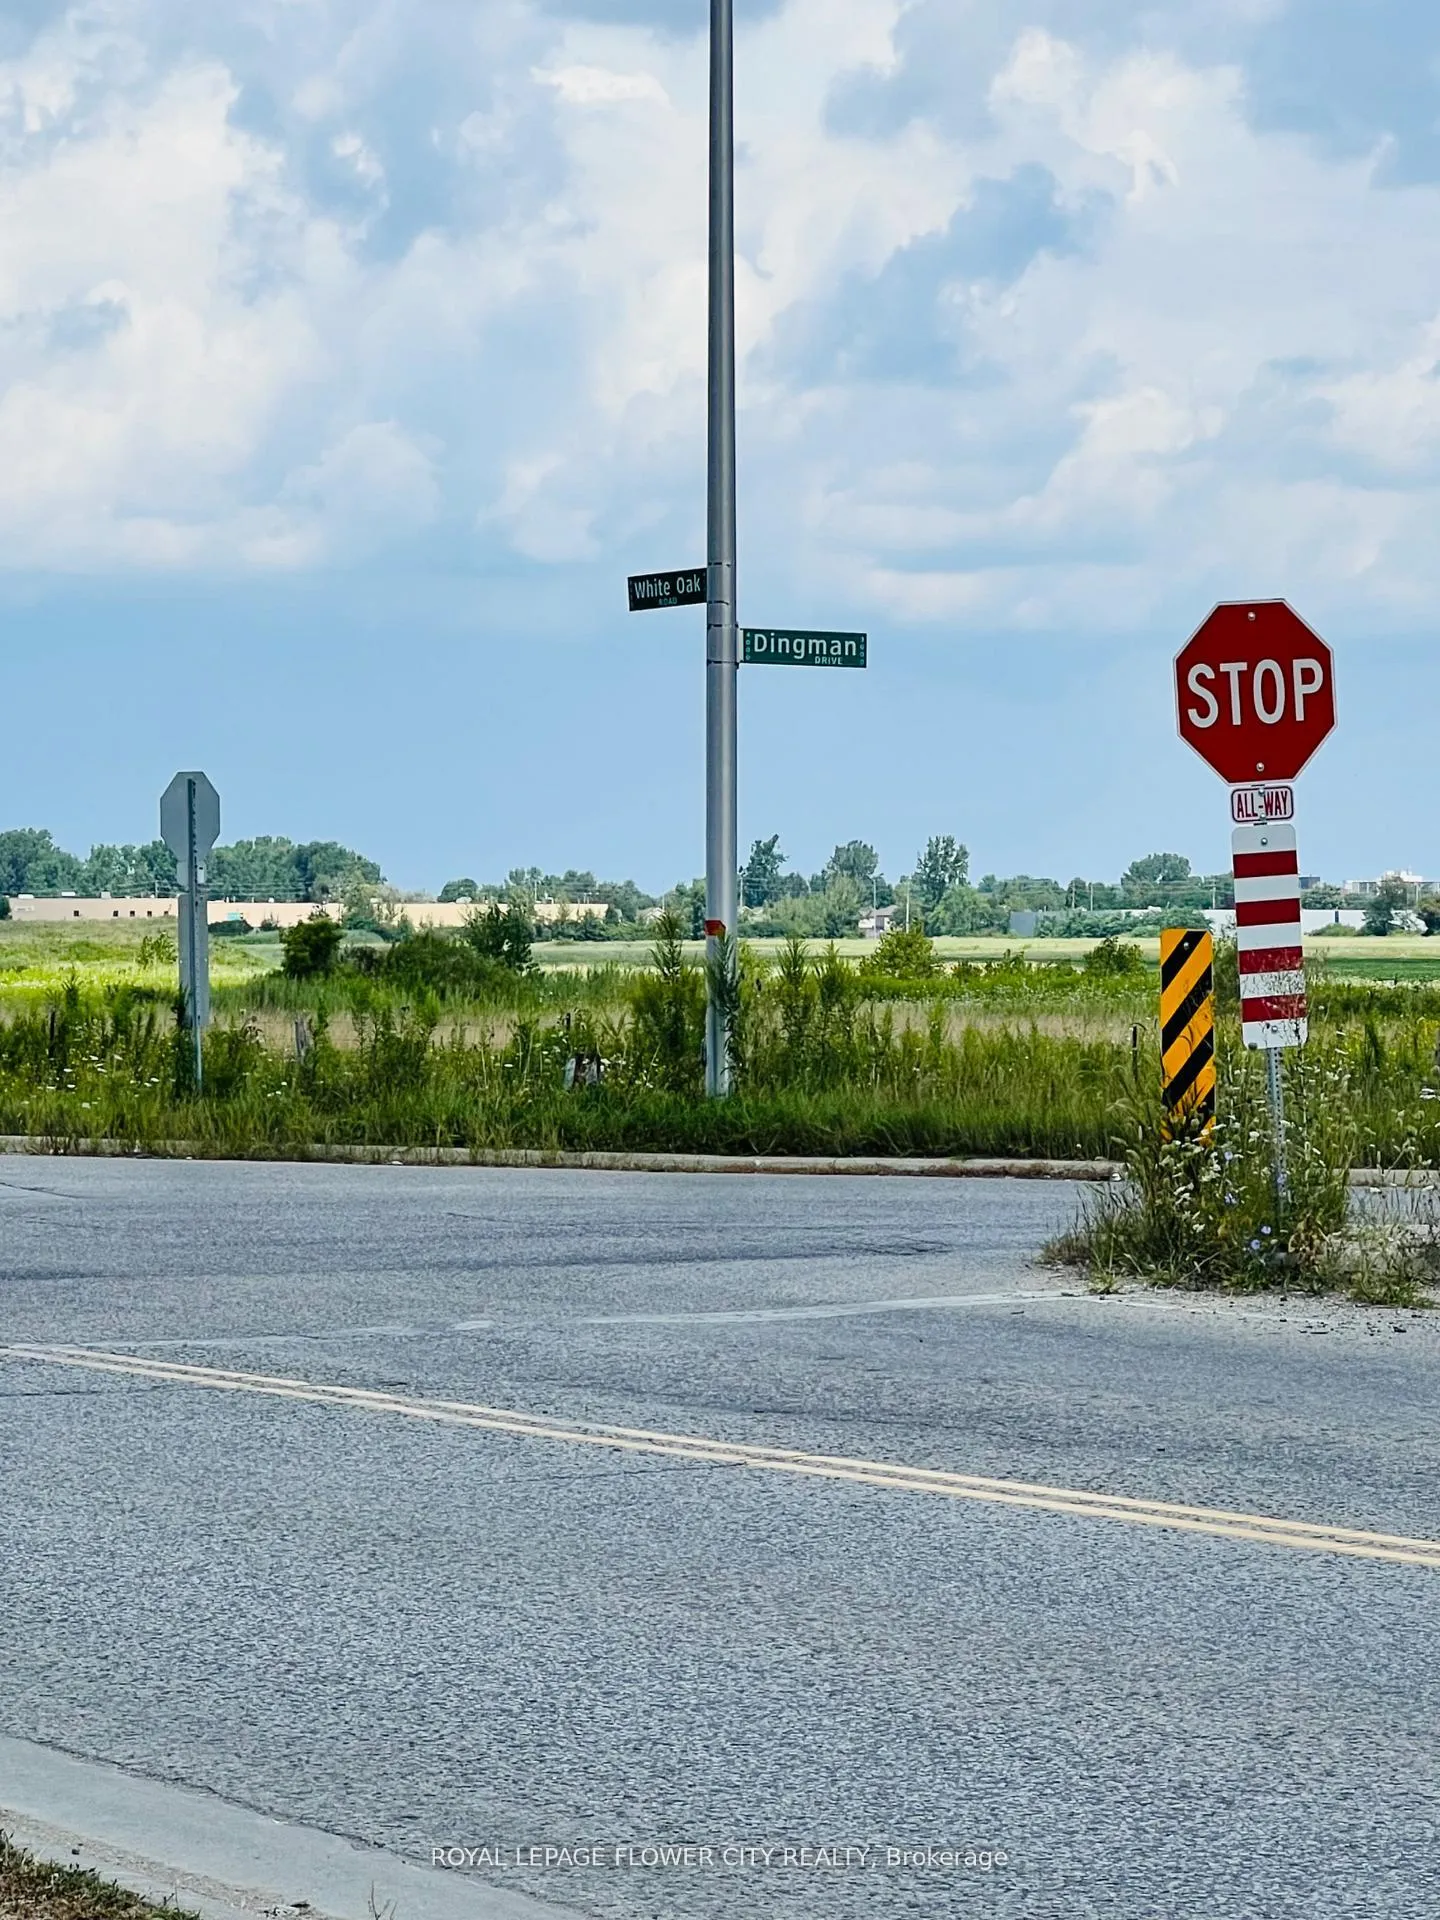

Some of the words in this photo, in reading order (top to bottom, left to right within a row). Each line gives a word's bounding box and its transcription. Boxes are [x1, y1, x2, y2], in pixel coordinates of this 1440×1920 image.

[634, 578, 671, 599] White
[676, 574, 701, 594] Oak
[659, 597, 678, 605] ROAD
[754, 632, 857, 660] Dingman
[814, 655, 843, 665] DRIVE
[1187, 658, 1324, 728] STOP
[1236, 790, 1288, 818] ALL-WAY
